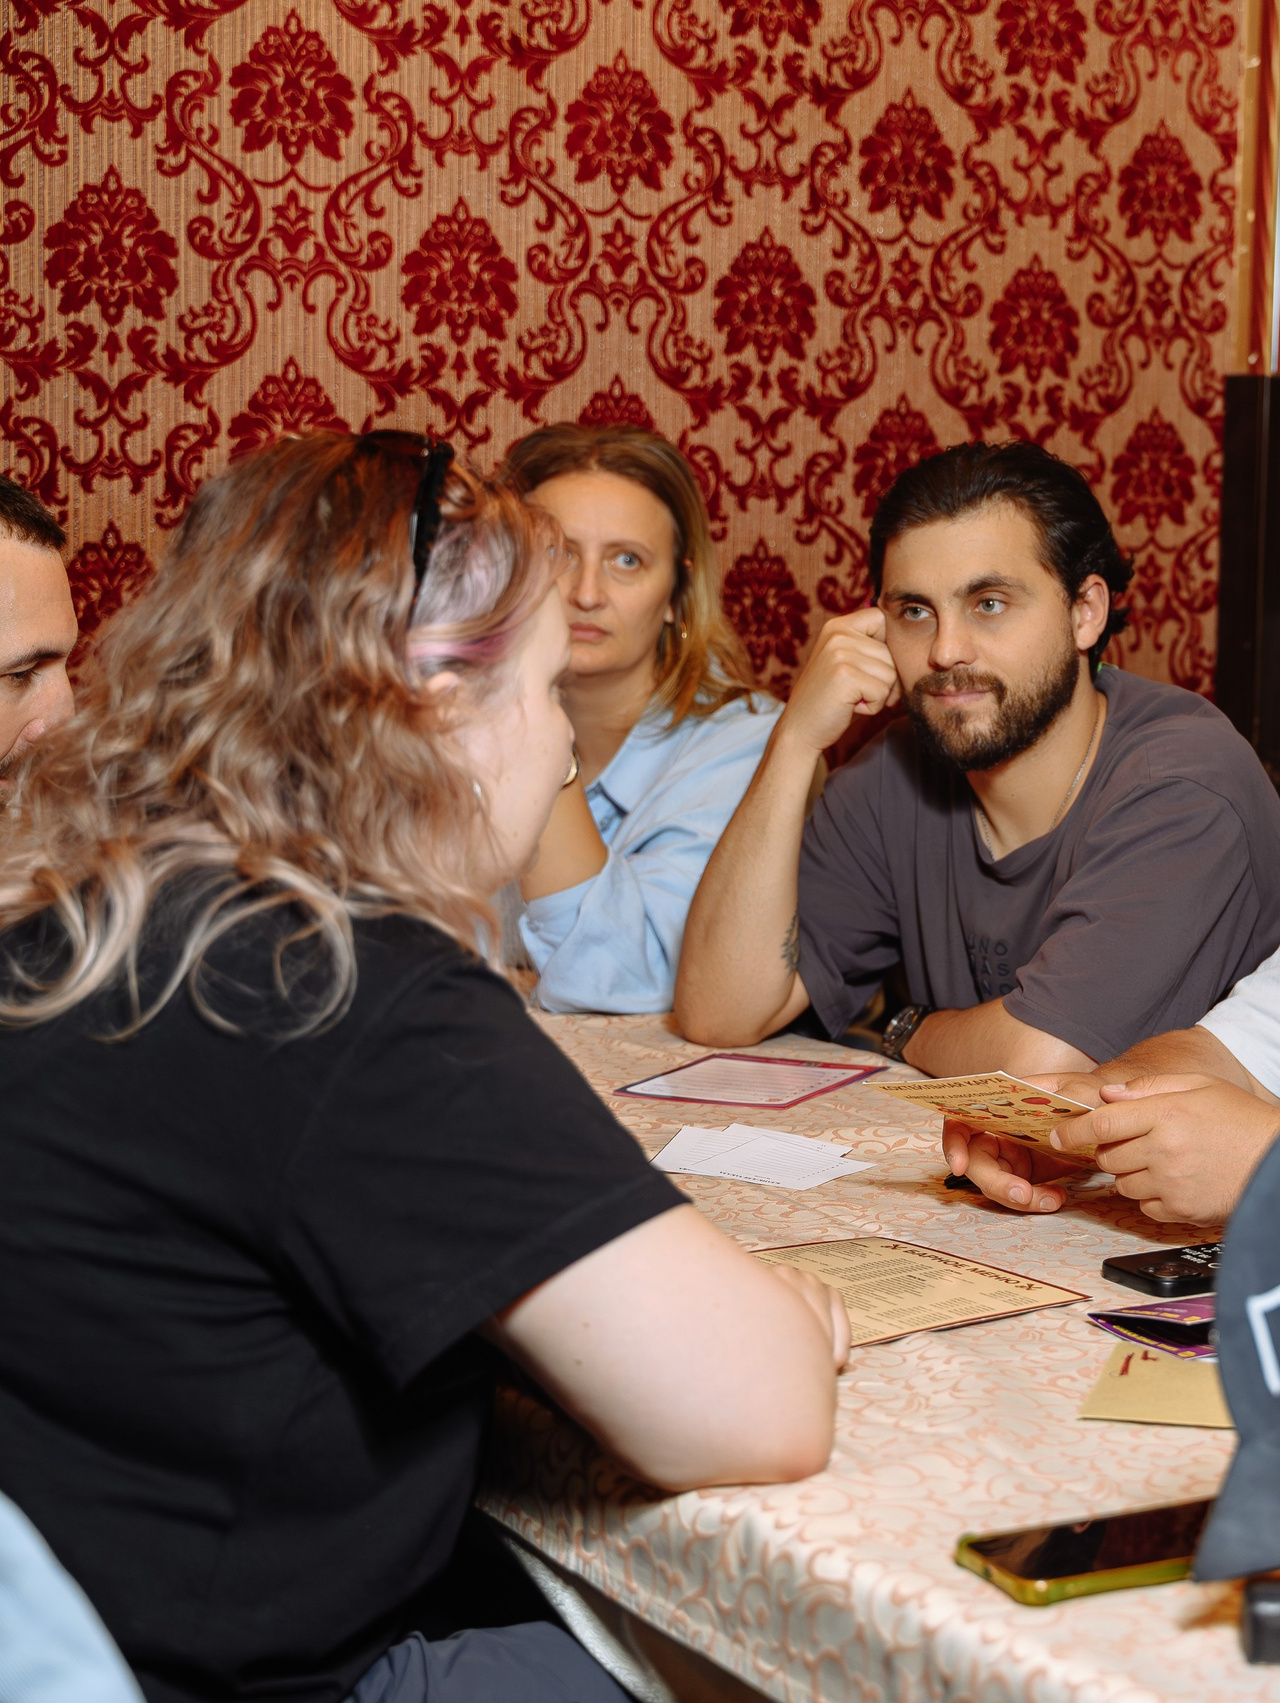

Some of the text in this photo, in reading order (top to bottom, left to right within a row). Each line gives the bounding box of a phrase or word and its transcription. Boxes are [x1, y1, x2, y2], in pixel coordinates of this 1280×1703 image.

[965, 1077, 1008, 1086] КАРТА
[903, 1249, 967, 1269] БАРНОЕ
[966, 1267, 1020, 1285] МЕНЮ
